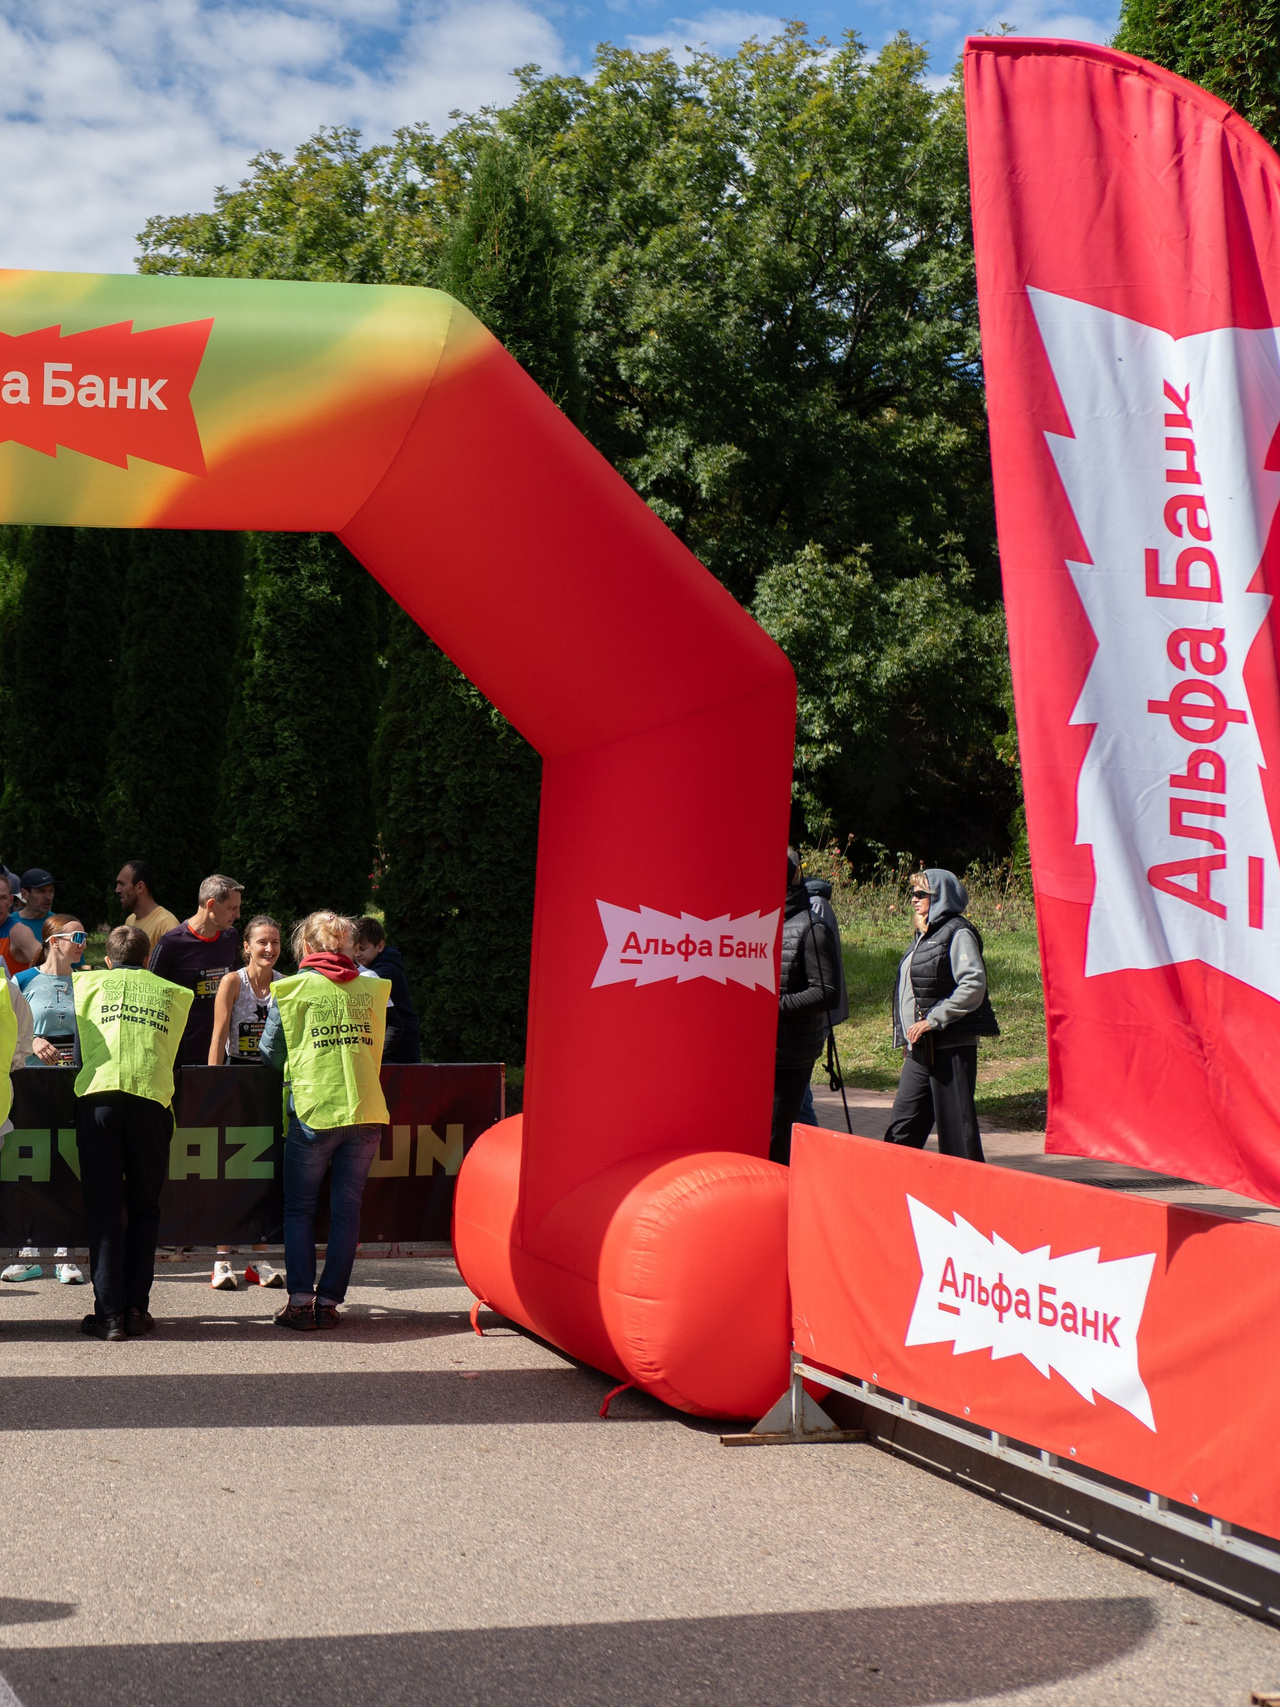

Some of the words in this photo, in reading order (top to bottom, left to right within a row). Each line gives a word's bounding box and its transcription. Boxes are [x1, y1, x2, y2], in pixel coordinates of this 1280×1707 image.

[43, 362, 169, 411] Банк
[1145, 379, 1224, 604] Банк
[1147, 627, 1249, 920] Альфа
[621, 930, 714, 962] Альфа
[718, 934, 769, 960] Банк
[102, 979, 174, 1001] САМЫЙ
[102, 990, 173, 1013] ЛУЧШИЙ
[306, 992, 374, 1009] САМЫЙ
[101, 1003, 170, 1023] ВОЛОНТЁР
[311, 1022, 373, 1038] ВОЛОНТЁ
[939, 1256, 1032, 1323] Альфа
[1037, 1283, 1123, 1349] Банк
